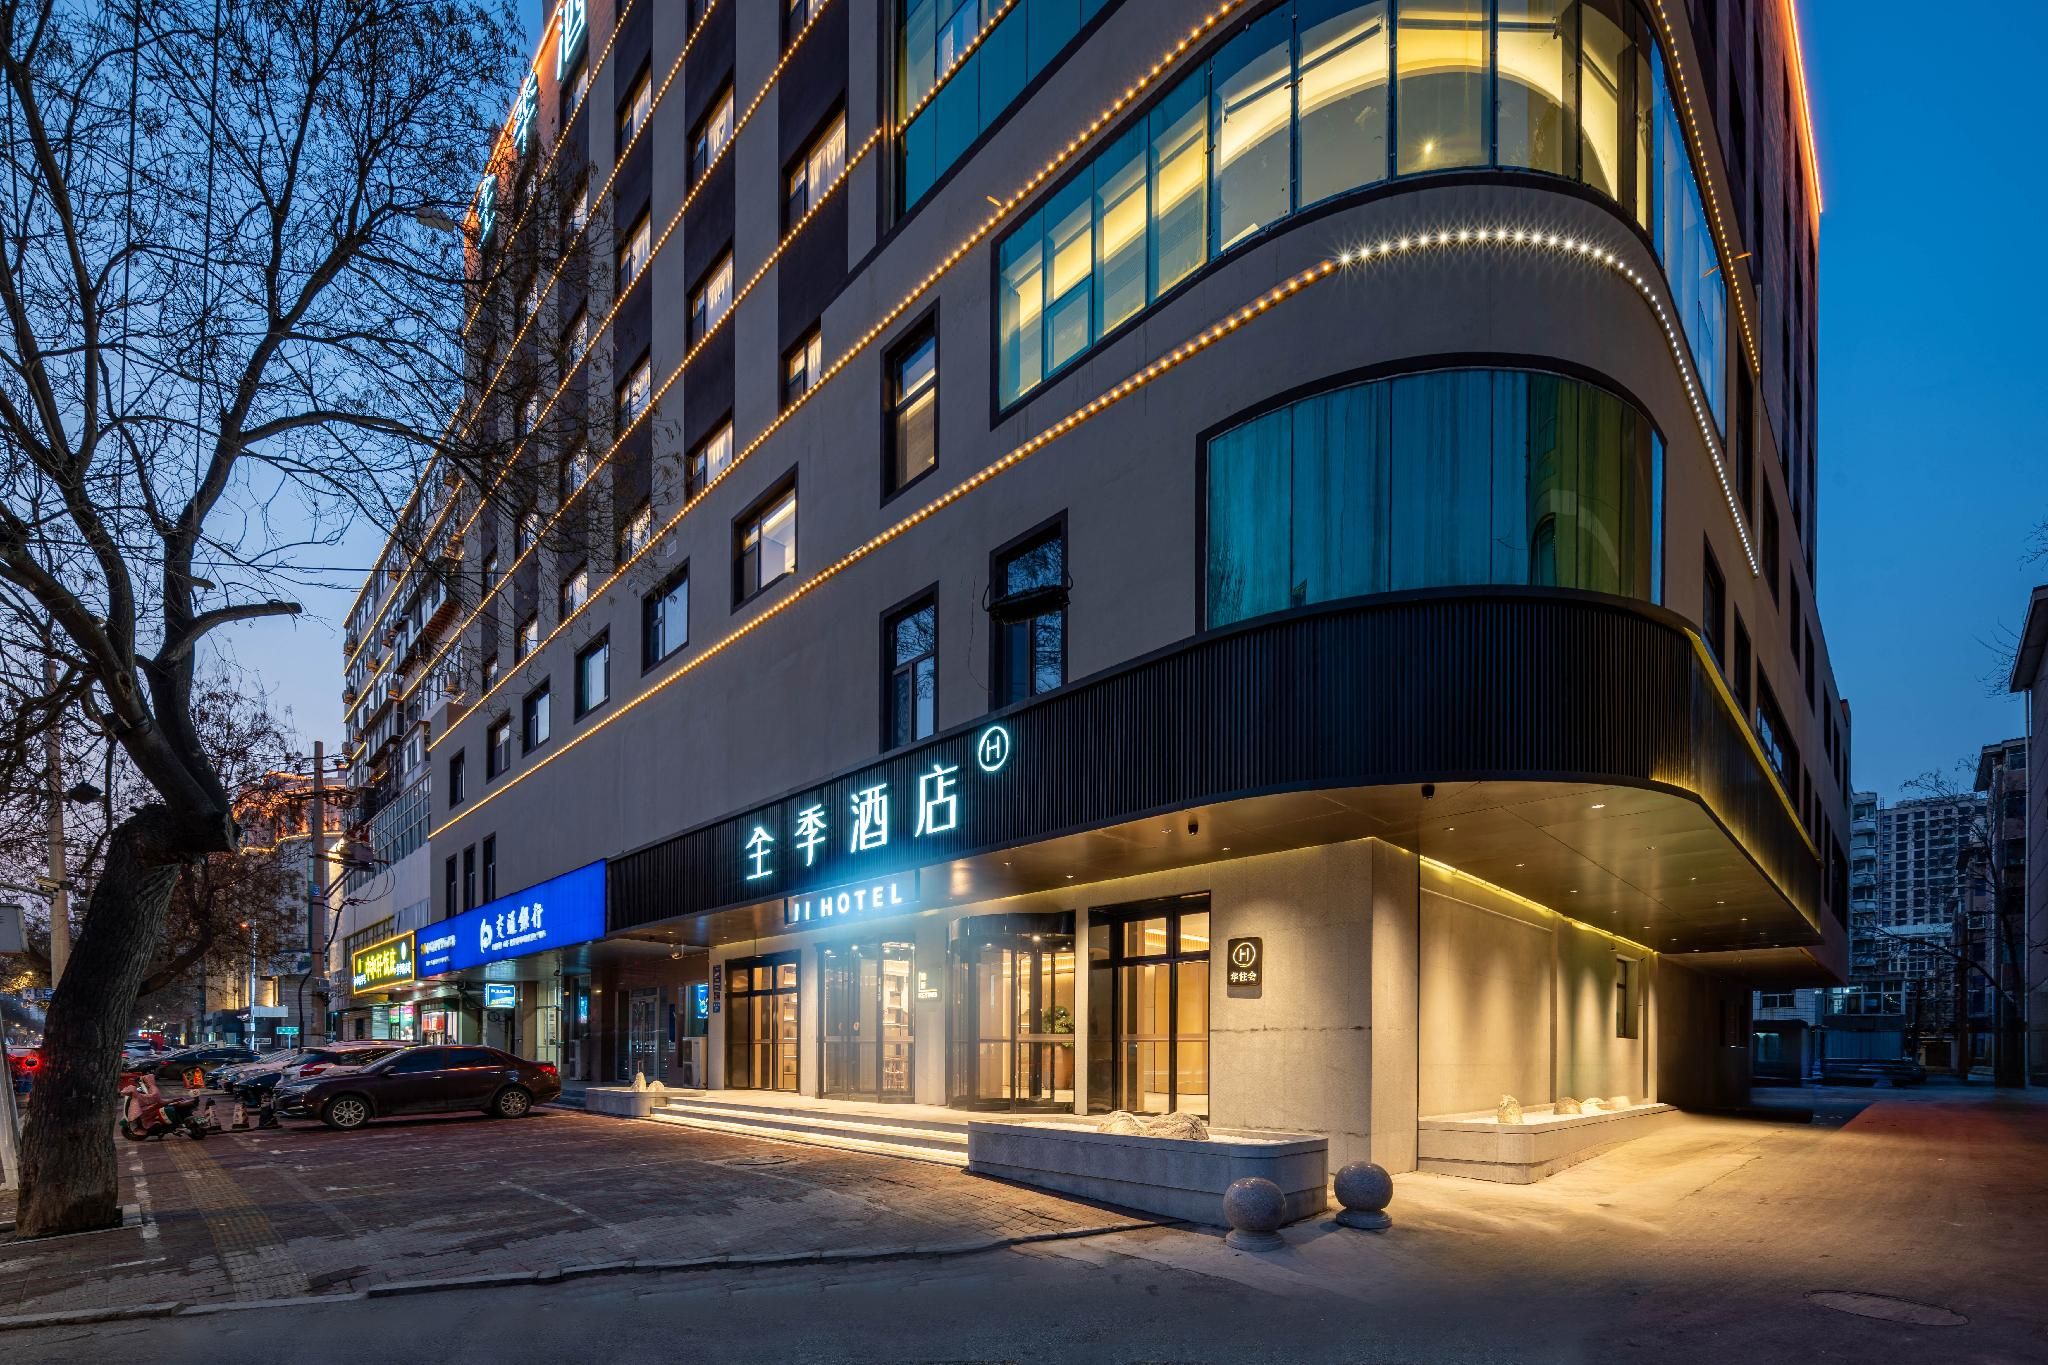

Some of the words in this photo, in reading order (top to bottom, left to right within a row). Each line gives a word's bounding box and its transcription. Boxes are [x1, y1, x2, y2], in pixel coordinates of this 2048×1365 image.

[745, 763, 958, 881] 全季酒店
[793, 902, 811, 922] JI
[820, 883, 903, 918] HOTEL
[1230, 971, 1257, 983] 华住会
